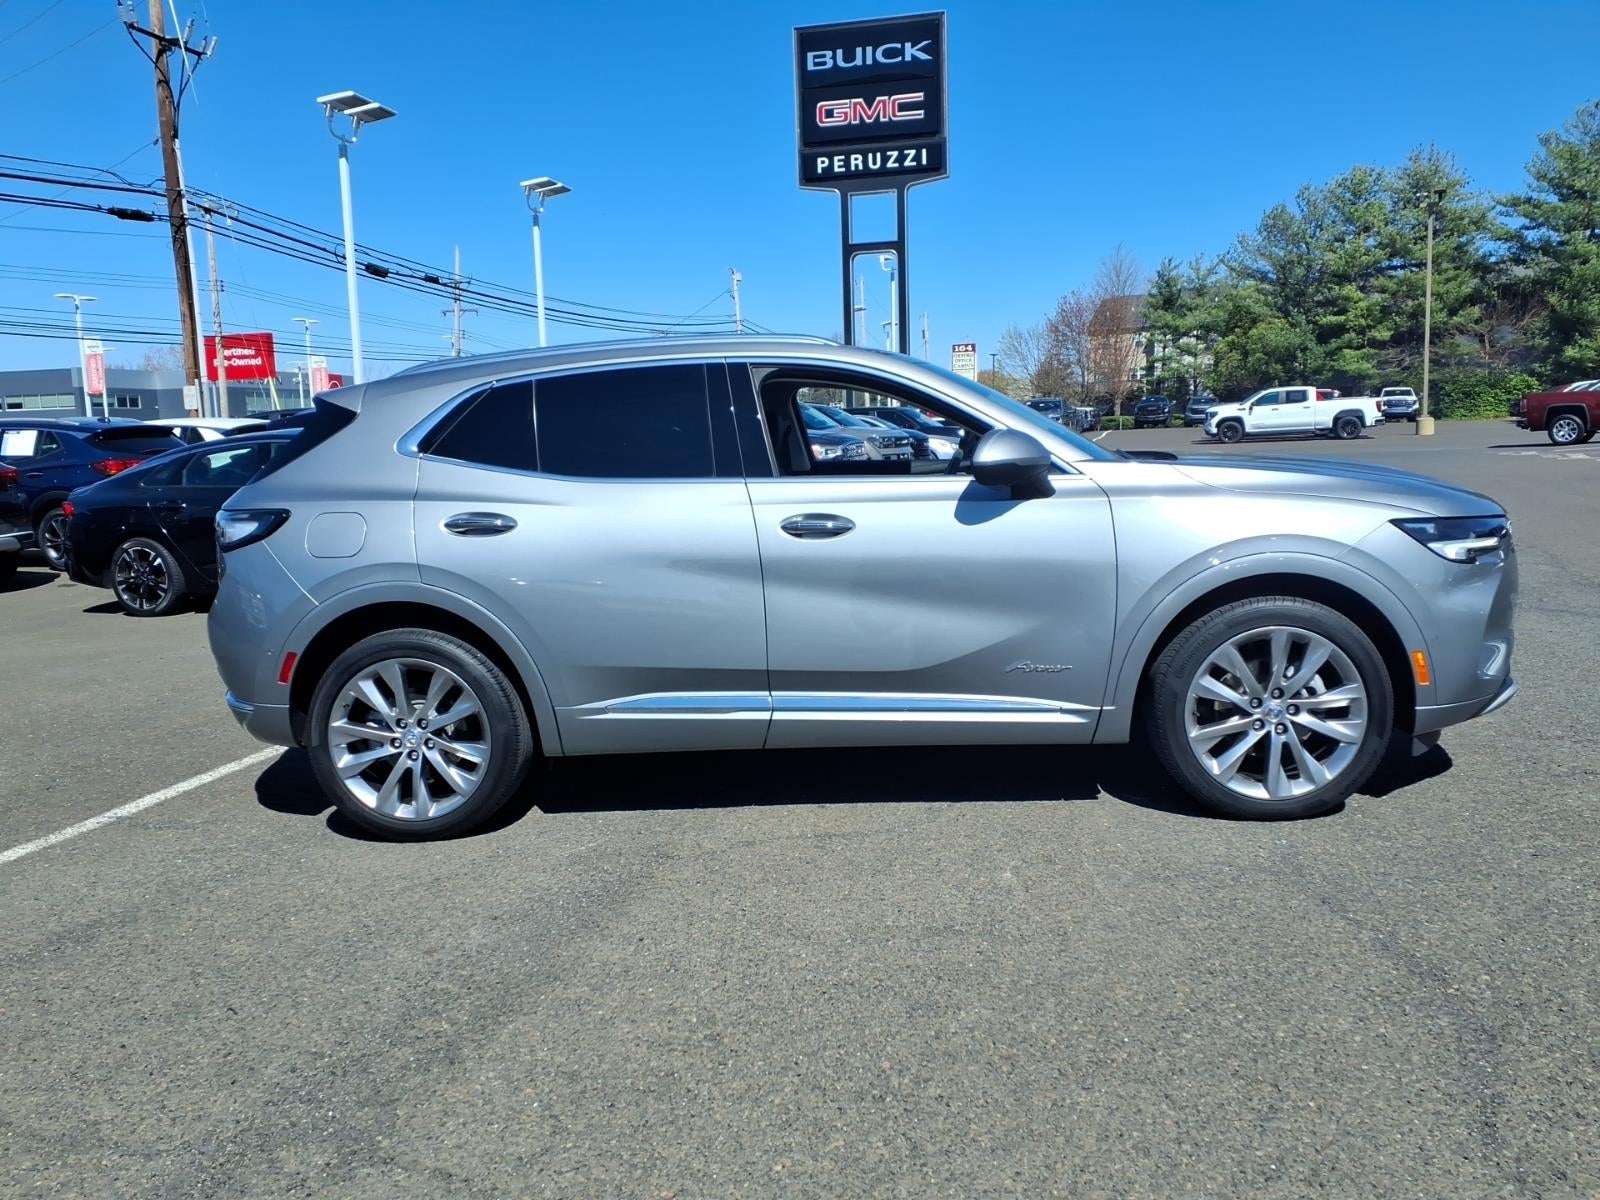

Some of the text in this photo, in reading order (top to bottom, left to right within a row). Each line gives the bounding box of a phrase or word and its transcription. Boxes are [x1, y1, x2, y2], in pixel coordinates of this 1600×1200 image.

[806, 39, 933, 71] BUICK
[816, 91, 924, 127] GMC
[816, 148, 927, 174] PERUZZI
[213, 357, 262, 367] Pe-Owned
[223, 347, 256, 357] ertified
